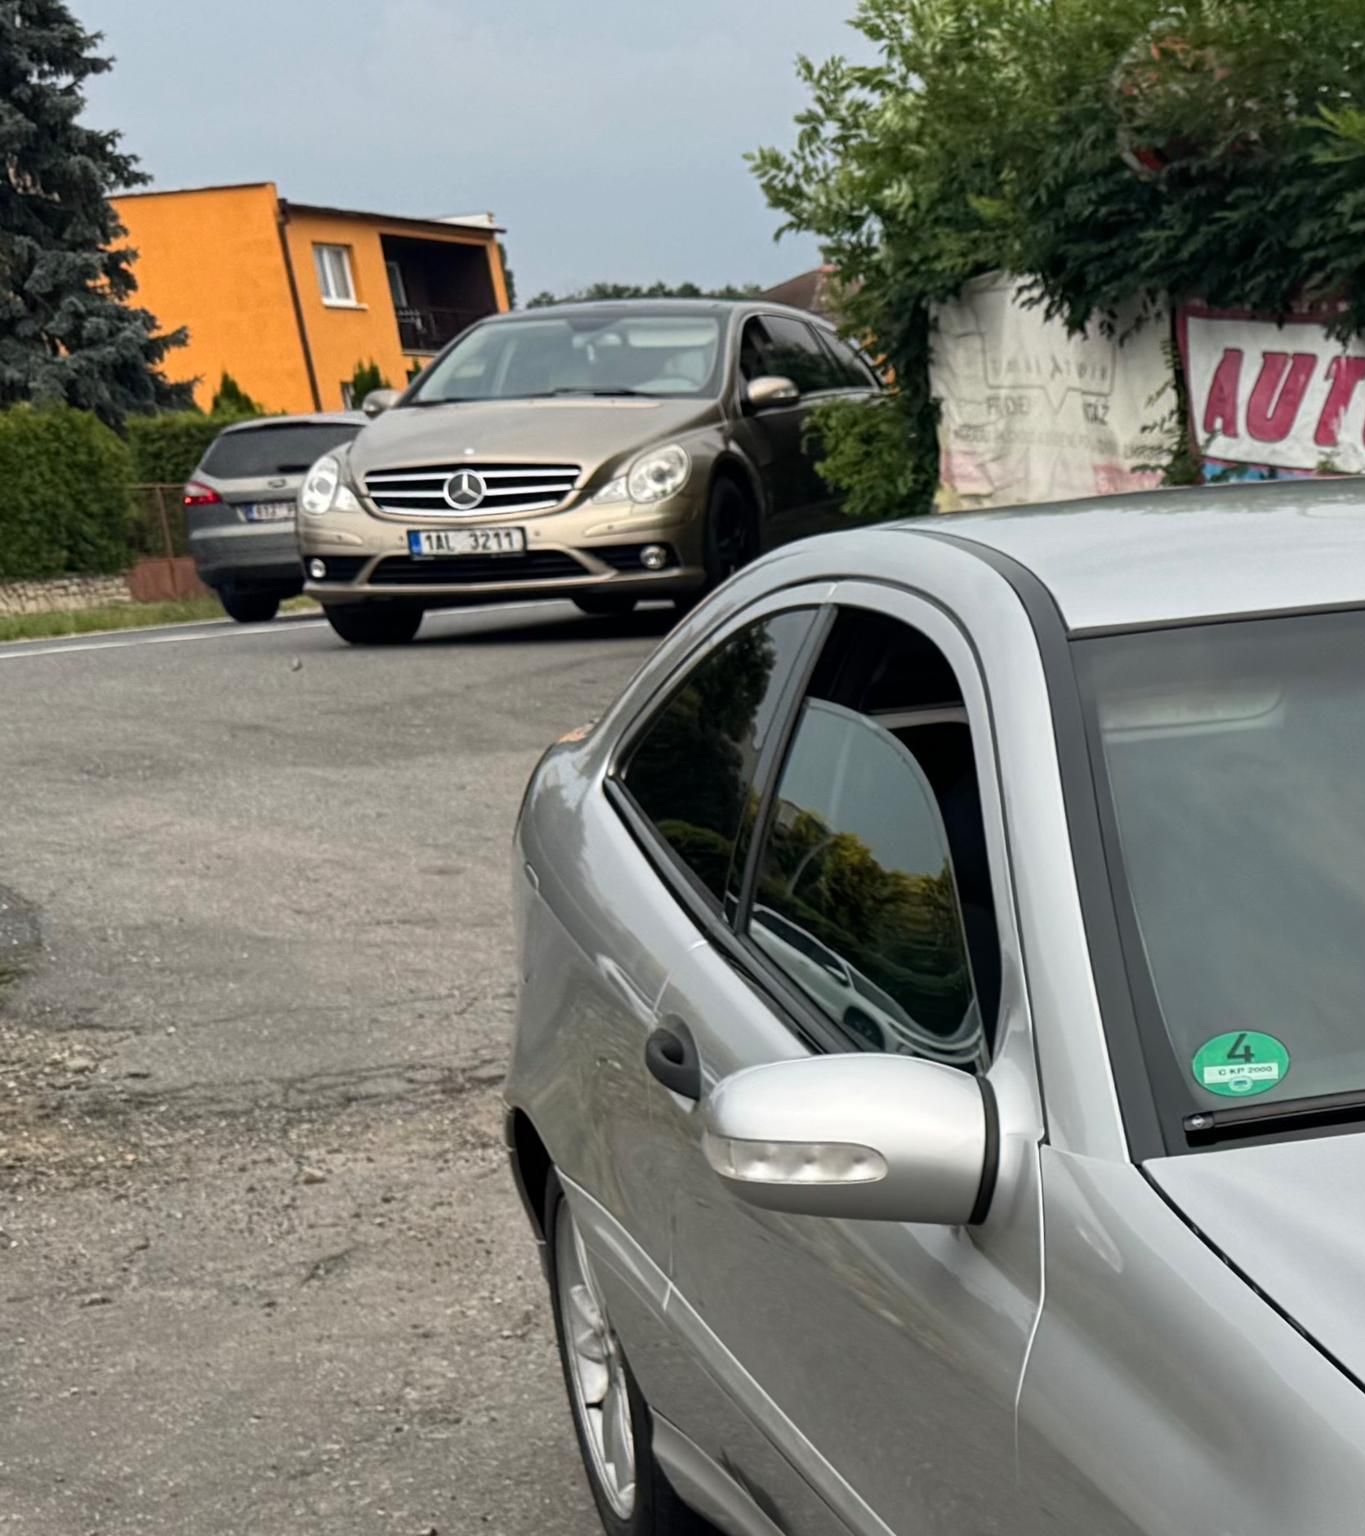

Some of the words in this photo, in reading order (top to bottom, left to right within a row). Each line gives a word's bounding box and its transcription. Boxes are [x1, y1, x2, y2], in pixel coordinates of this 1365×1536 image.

[424, 533, 456, 552] 1AL
[468, 531, 515, 551] 3211
[1226, 1032, 1255, 1064] 4
